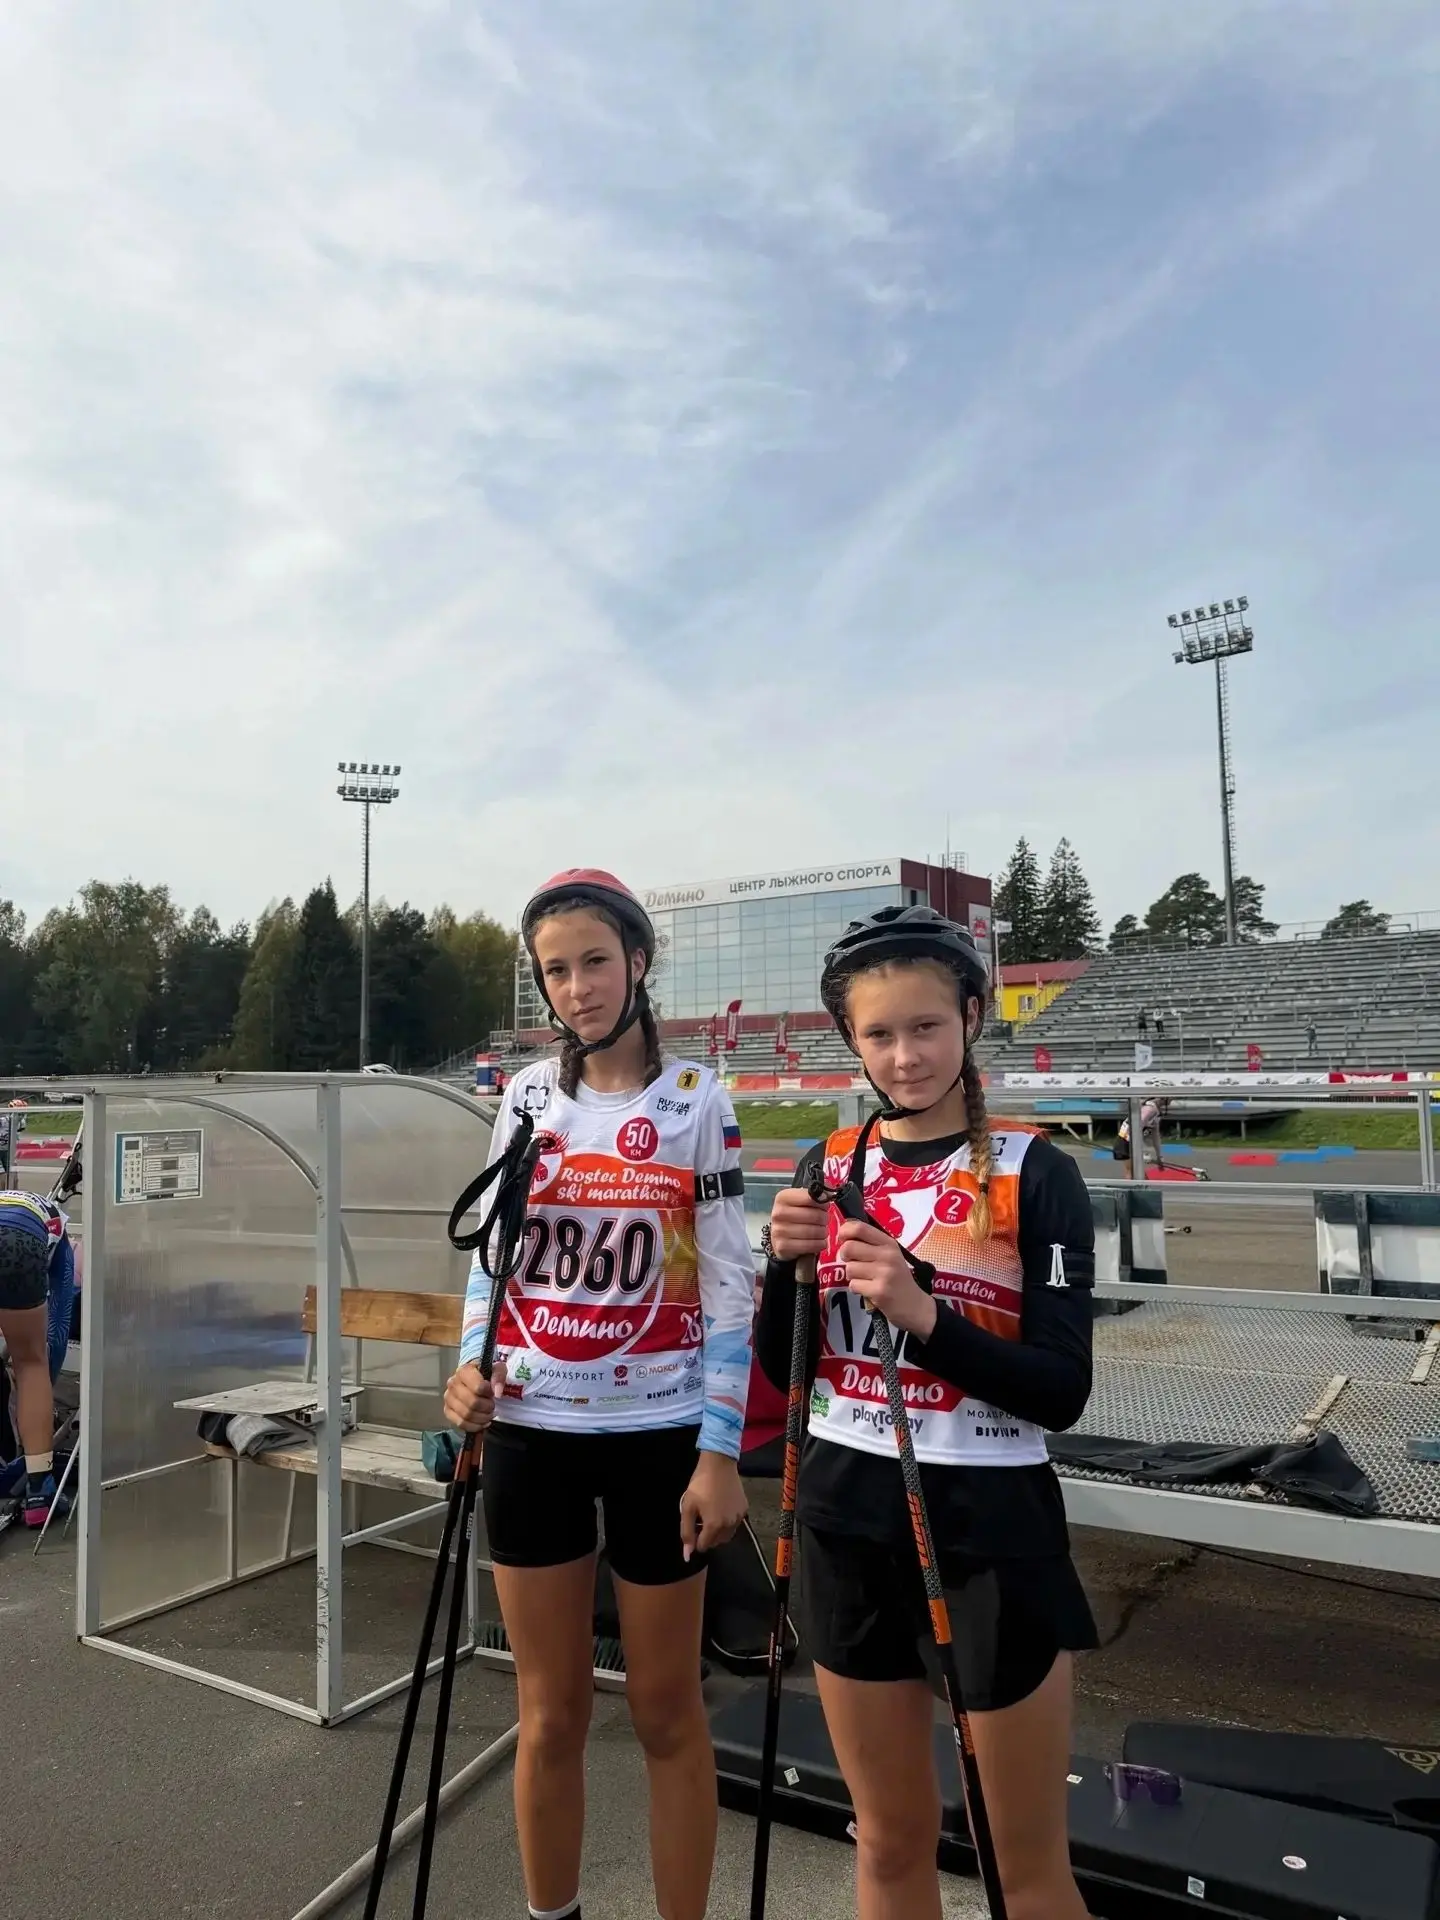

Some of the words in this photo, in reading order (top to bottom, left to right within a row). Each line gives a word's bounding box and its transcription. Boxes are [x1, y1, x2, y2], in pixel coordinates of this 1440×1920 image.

[729, 881, 766, 895] ЦЕНТР
[769, 871, 834, 888] ЛЫЖНОГО
[837, 865, 892, 881] СПОРТА
[624, 1122, 651, 1149] 50
[560, 1167, 617, 1185] Rostec
[621, 1167, 681, 1188] Demino
[557, 1183, 584, 1202] ski
[587, 1184, 669, 1201] marathon
[947, 1195, 962, 1215] 2
[523, 1214, 657, 1295] 2860
[931, 1276, 998, 1301] arathon
[530, 1306, 634, 1339] Демино
[539, 1367, 605, 1381] MOAXSPORT
[647, 1388, 679, 1400] BIVIUM
[853, 1405, 924, 1434] playToay
